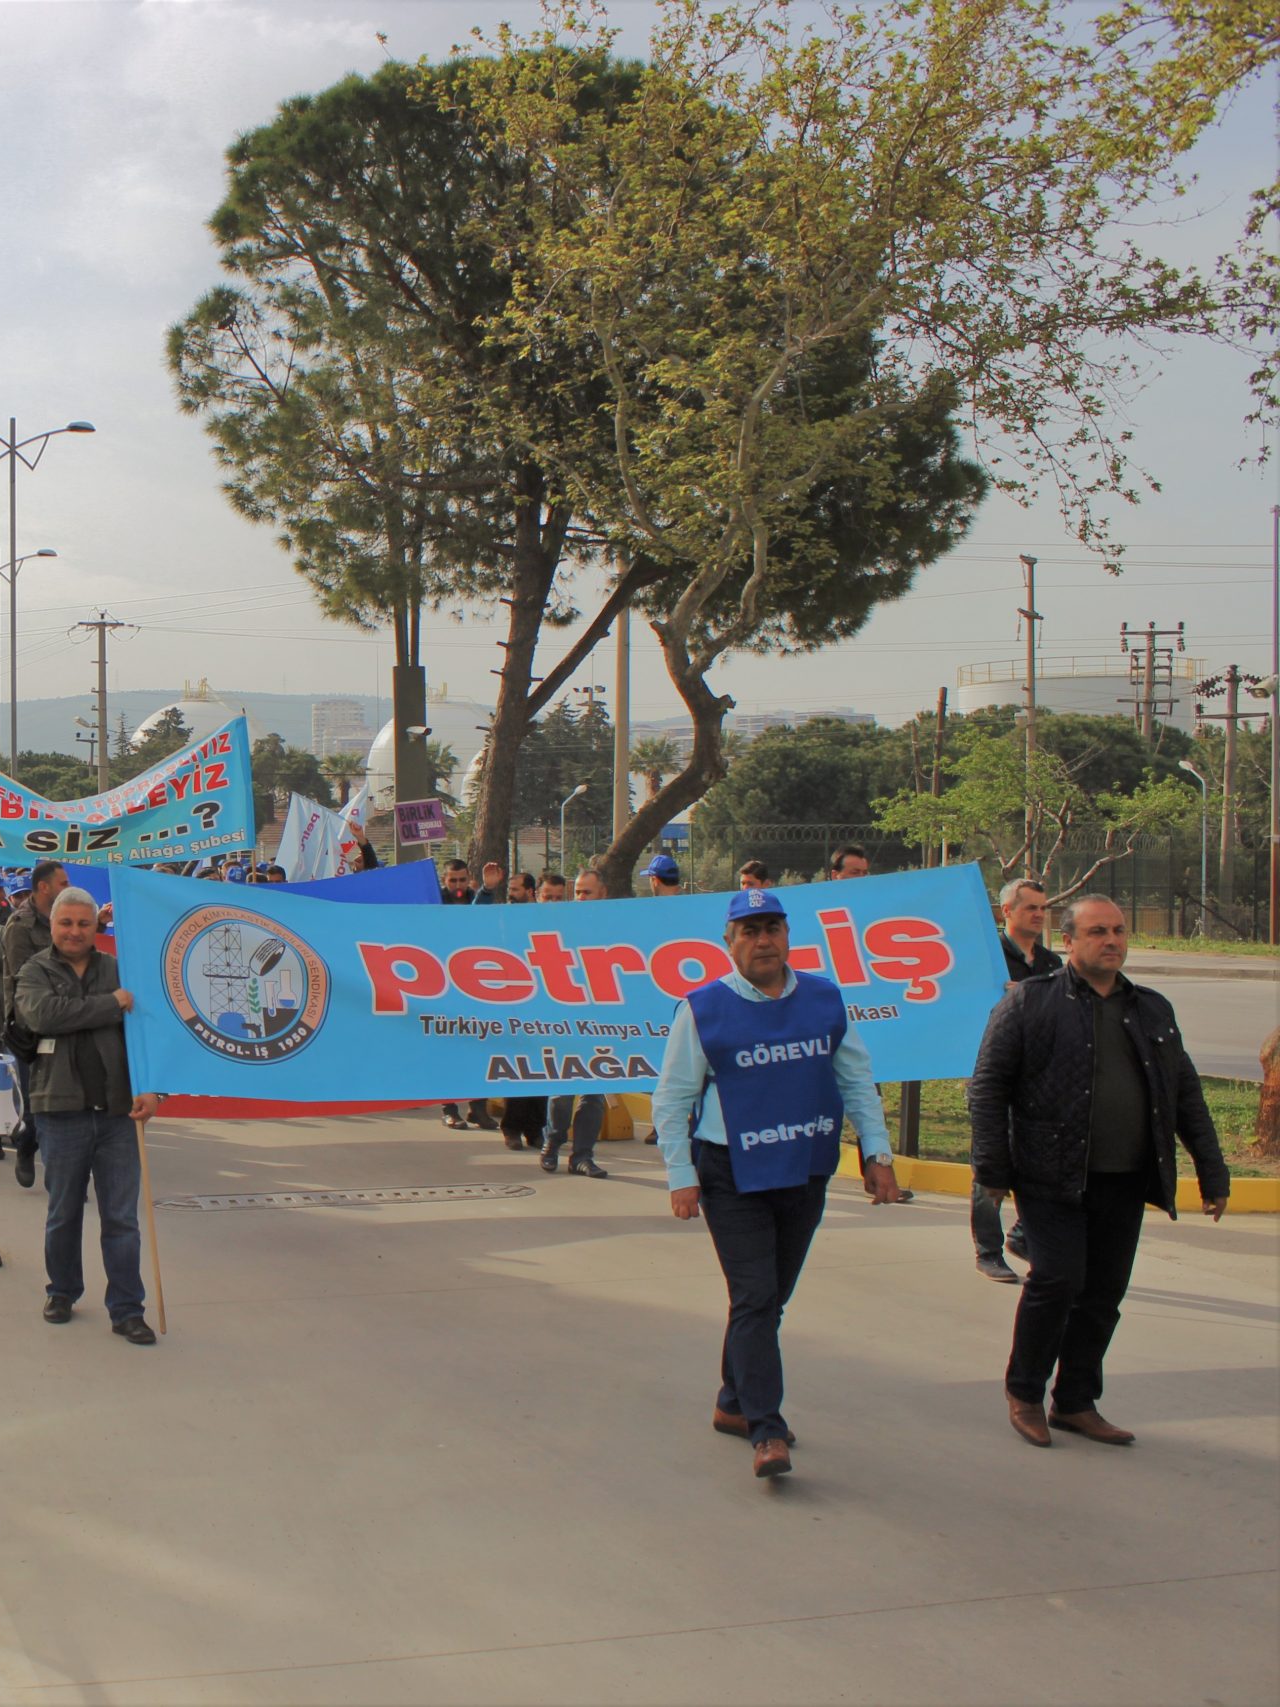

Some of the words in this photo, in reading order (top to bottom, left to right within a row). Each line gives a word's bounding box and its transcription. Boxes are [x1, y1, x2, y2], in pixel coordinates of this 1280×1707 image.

[24, 823, 120, 853] SİZ
[129, 843, 184, 861] Aliağa
[191, 829, 246, 855] şubesi
[173, 922, 204, 956] PETROL
[306, 958, 321, 1019] SENDİKASI
[356, 906, 955, 1014] petro-iş
[277, 1026, 308, 1051] 1950
[419, 1015, 504, 1040] Türkiye
[509, 1018, 572, 1037] Petrol
[576, 1020, 640, 1041] Kimya
[847, 1004, 899, 1022] ikası
[486, 1047, 659, 1081] ALİAĞA
[735, 1035, 831, 1069] GÖREVLİ
